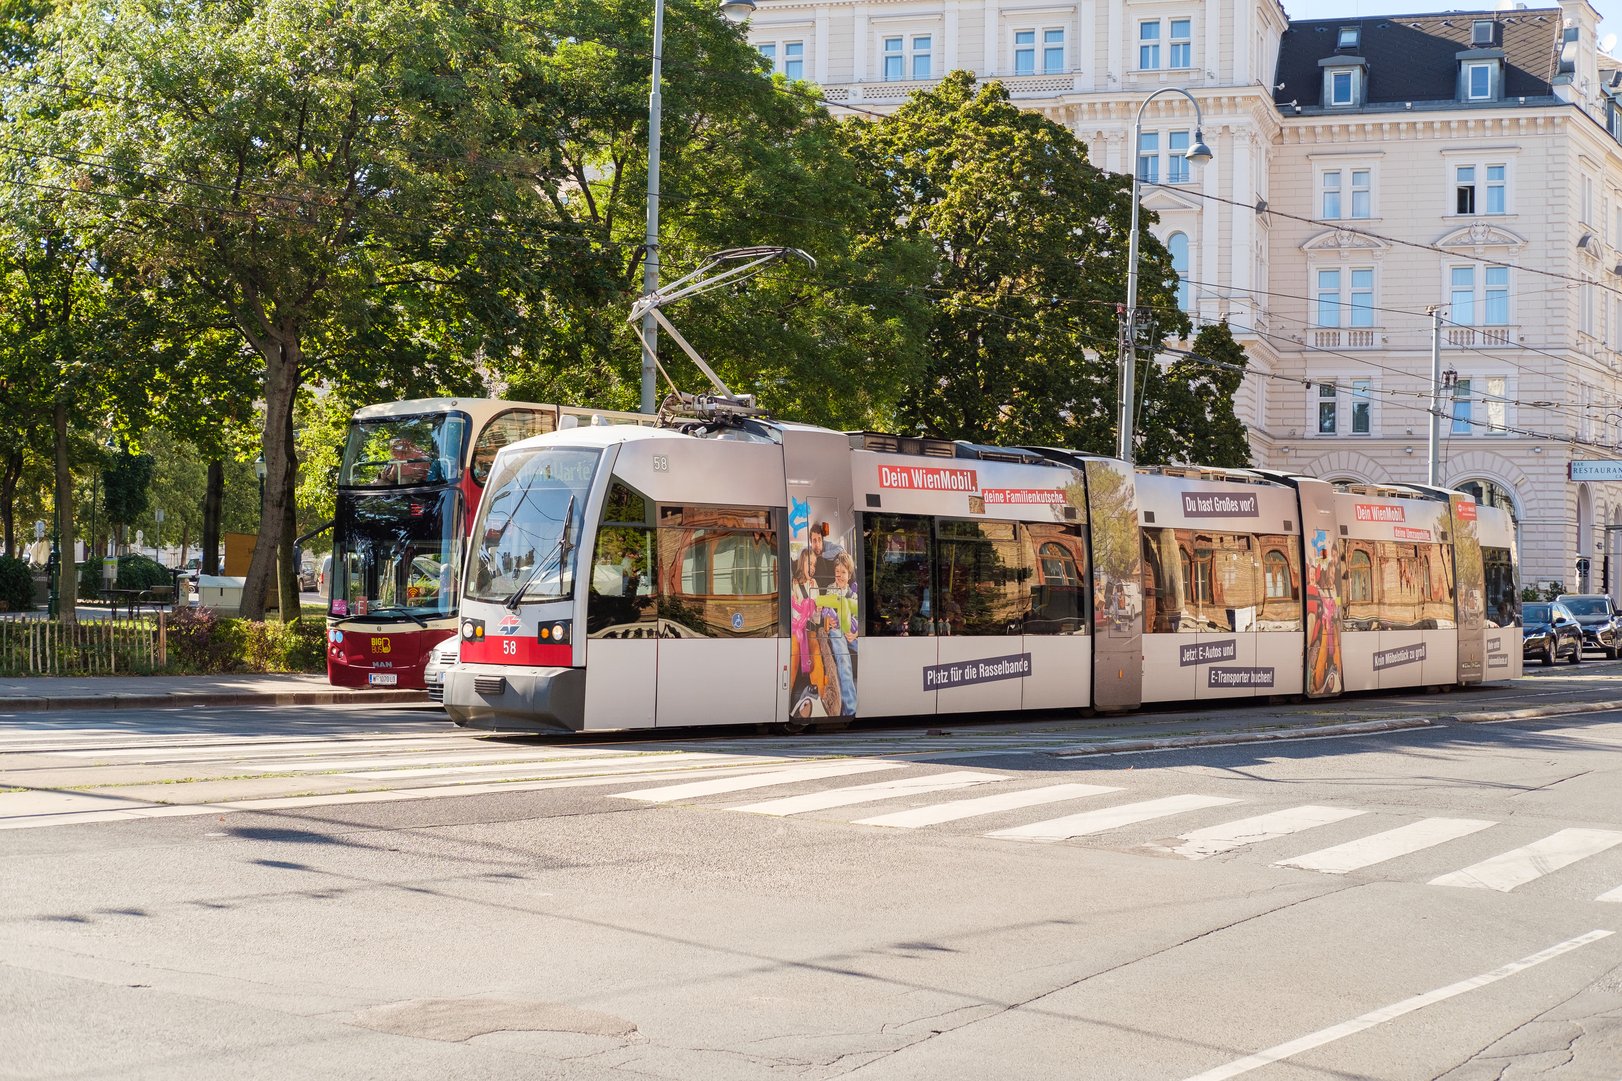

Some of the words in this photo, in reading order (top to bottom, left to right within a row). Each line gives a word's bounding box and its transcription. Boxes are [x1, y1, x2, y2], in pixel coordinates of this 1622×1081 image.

[653, 456, 668, 471] 58
[882, 467, 909, 488] Dein
[912, 469, 976, 493] WienMobil,
[984, 490, 1005, 503] deine
[1006, 490, 1066, 505] Familienkutsche.
[1185, 496, 1196, 512] Du
[1197, 496, 1213, 512] hast
[1214, 497, 1239, 512] Großes
[1240, 498, 1255, 512] vor?
[1356, 505, 1371, 520] Dein
[371, 637, 382, 646] BIG
[503, 640, 516, 655] 58
[1182, 648, 1198, 662] Jetzt
[1199, 646, 1222, 660] E-Autos
[1223, 643, 1234, 656] und
[1374, 654, 1385, 667] Kein
[927, 670, 948, 685] Platz
[950, 667, 962, 682] für
[964, 665, 977, 680] die
[979, 658, 1028, 678] Rasselbande
[1210, 670, 1249, 686] E-Transporter
[1250, 670, 1273, 683] buchen!
